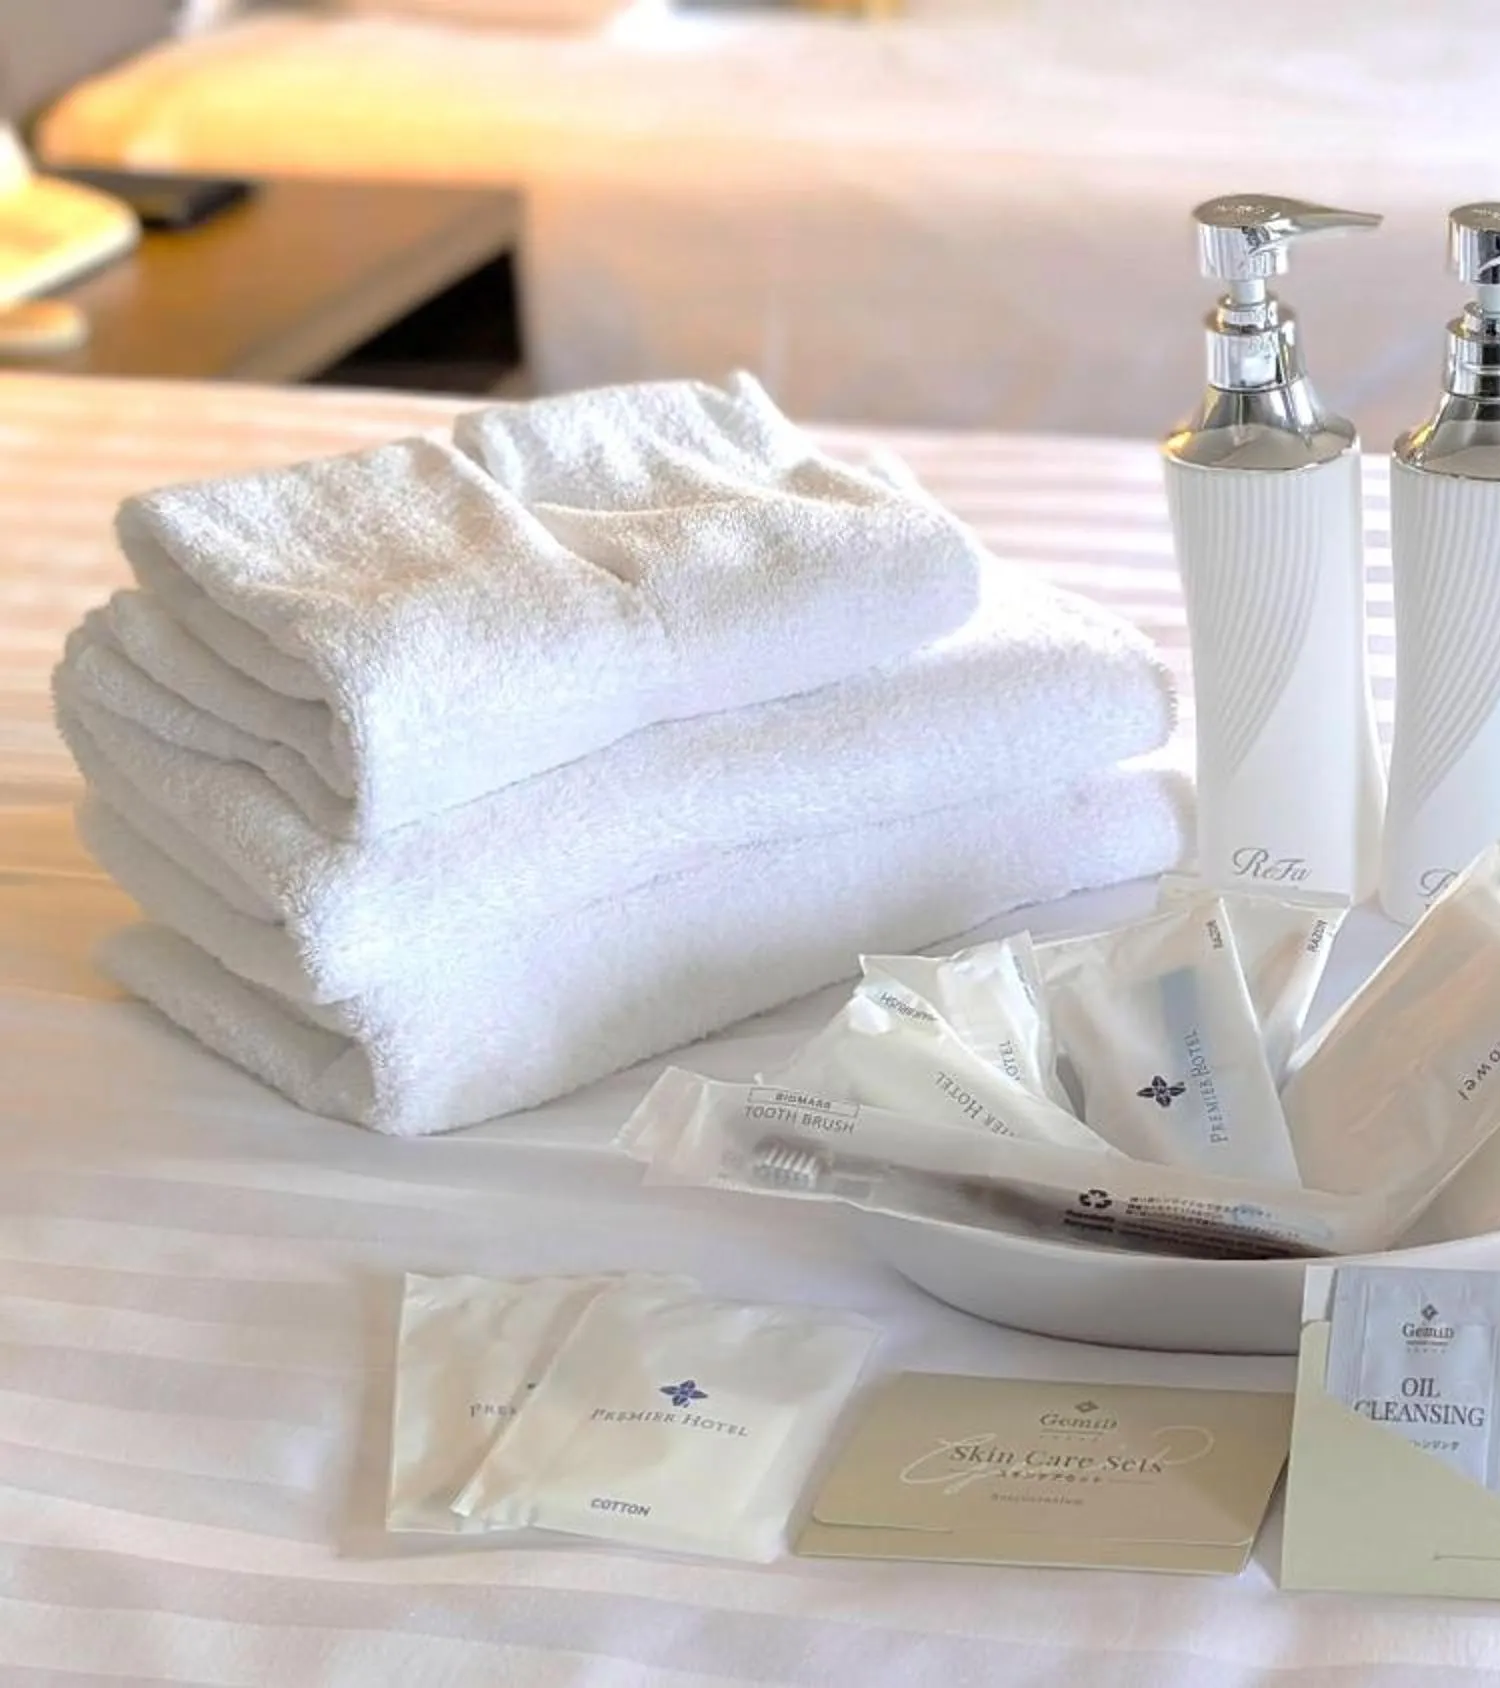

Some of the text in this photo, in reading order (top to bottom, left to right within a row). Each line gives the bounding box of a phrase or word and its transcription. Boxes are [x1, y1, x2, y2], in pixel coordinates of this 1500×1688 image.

[1231, 847, 1312, 881] ReFa
[999, 1039, 1021, 1082] OTEL
[934, 1070, 984, 1120] HOTEL
[744, 1105, 856, 1135] TOOTH BRUSH
[1401, 1376, 1441, 1398] OIL
[589, 1406, 750, 1438] PREMIER HOTEL
[1354, 1399, 1486, 1427] CLEANSING
[949, 1445, 1163, 1475] Skin Care Sets
[590, 1498, 652, 1518] COTTON
